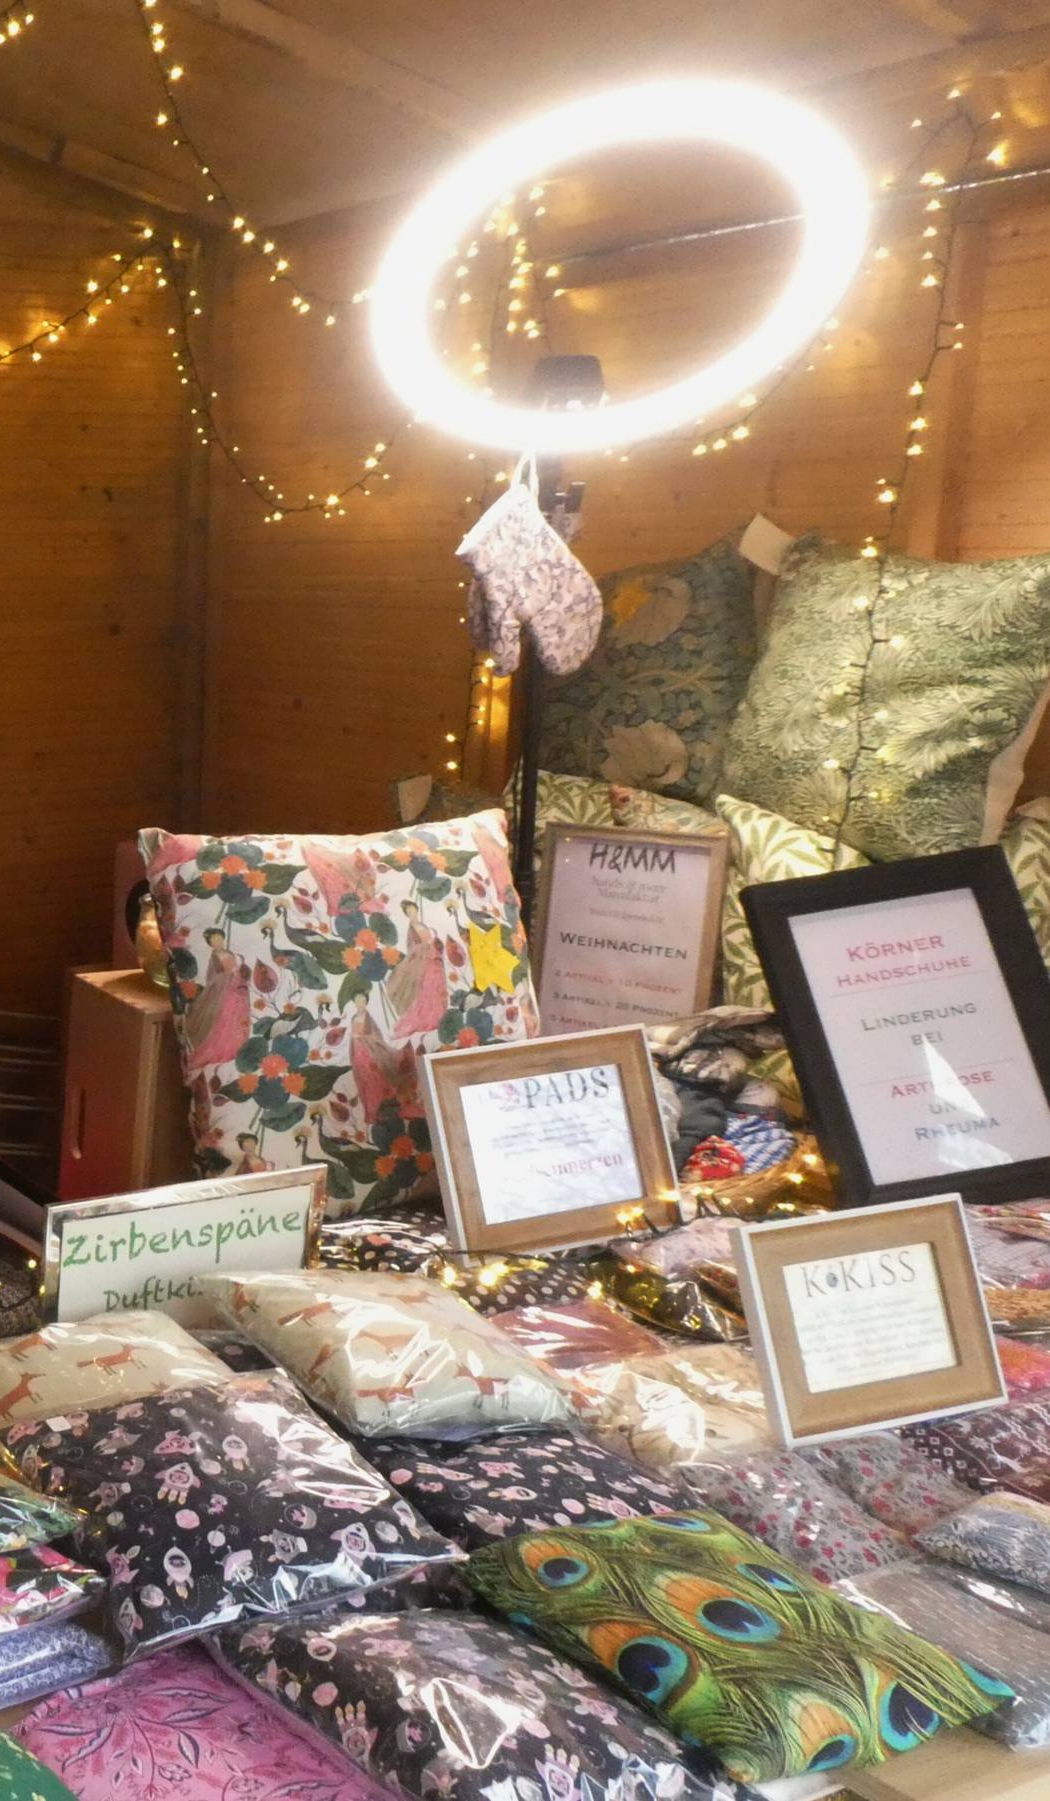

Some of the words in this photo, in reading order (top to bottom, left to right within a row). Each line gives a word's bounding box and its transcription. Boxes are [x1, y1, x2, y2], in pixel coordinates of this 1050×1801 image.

[589, 843, 676, 873] H&MM
[560, 932, 688, 960] WEIHNACHTEN
[846, 935, 945, 962] KÖRNER
[837, 955, 972, 988] HANDSCHUHE
[862, 1002, 977, 1031] LINDERUNG
[911, 1032, 943, 1045] BEI
[524, 1067, 610, 1109] PADS
[890, 1070, 994, 1098] ARTOSE
[915, 1116, 1001, 1141] RHEUMA
[62, 1208, 301, 1268] Zirbenspäne
[103, 1275, 203, 1312] Duftki
